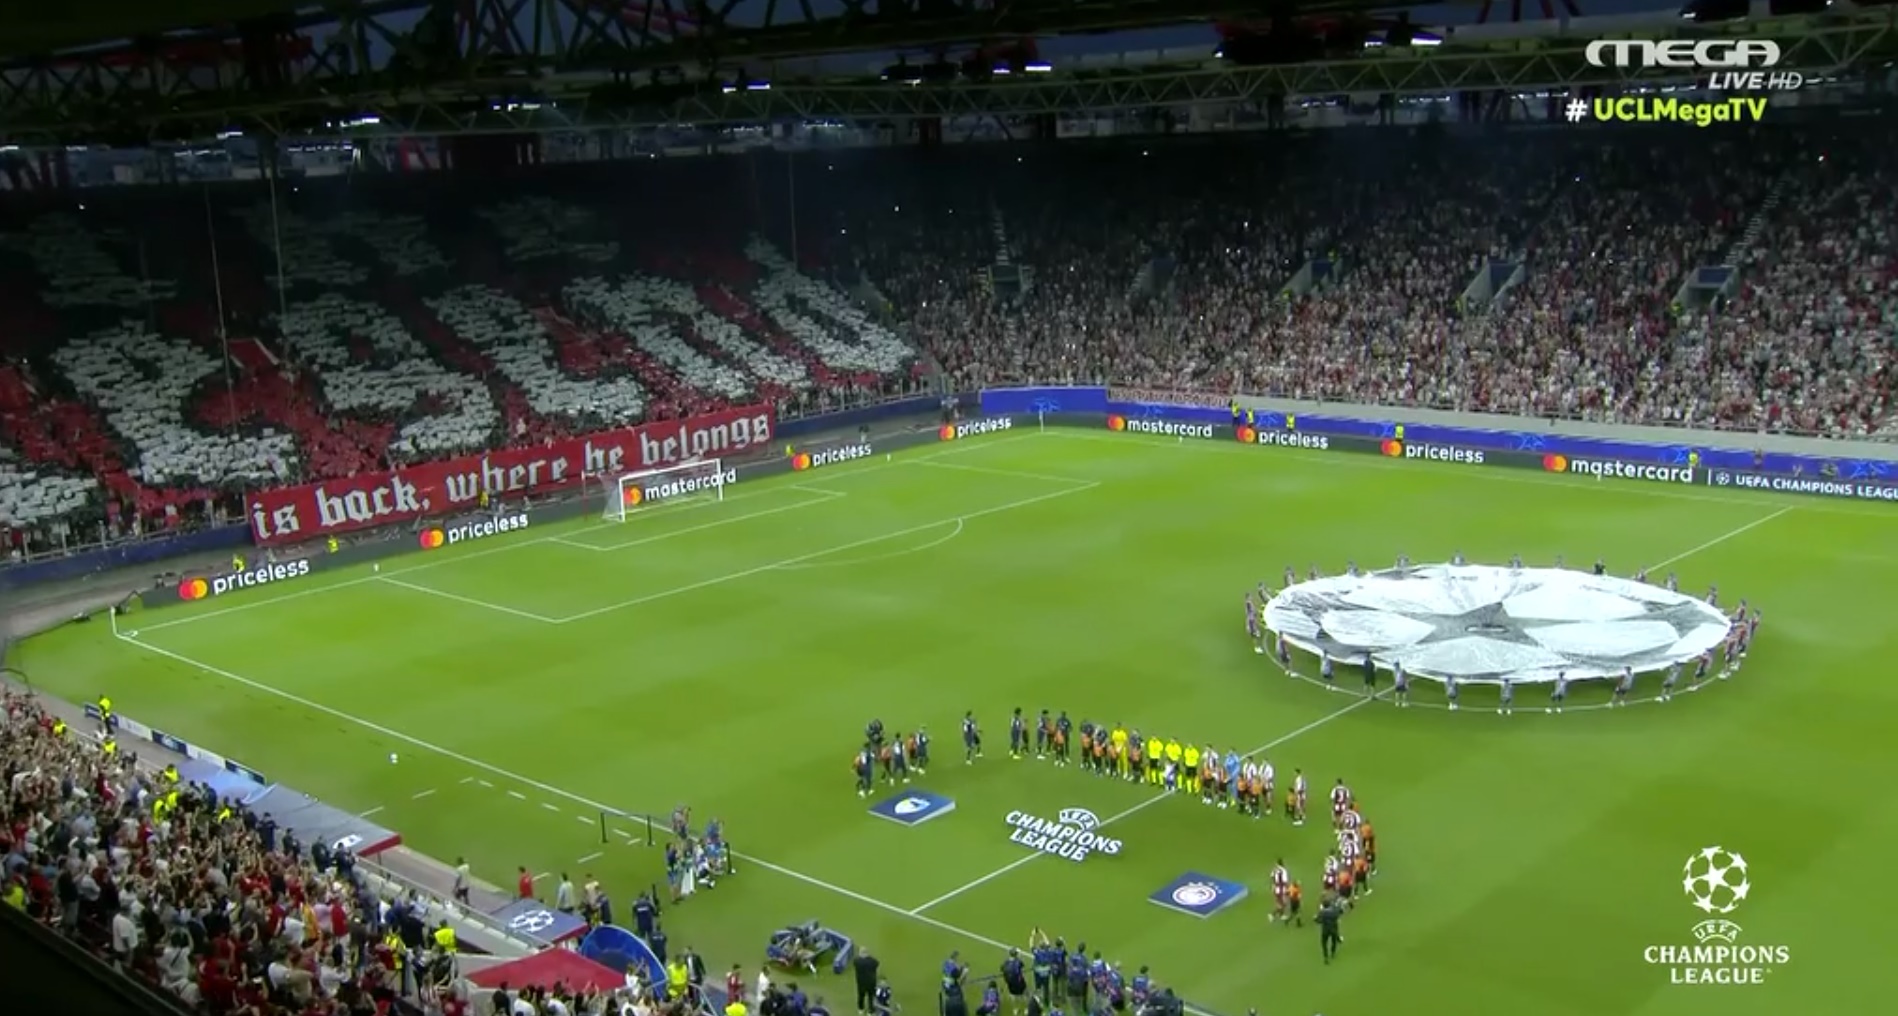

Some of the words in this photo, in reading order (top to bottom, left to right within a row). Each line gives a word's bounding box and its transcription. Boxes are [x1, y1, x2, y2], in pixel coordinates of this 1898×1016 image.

[957, 416, 1011, 438] priceless
[1127, 418, 1213, 438] mastercard
[1258, 431, 1328, 449] priceless
[812, 442, 871, 467] priceless
[1405, 444, 1484, 463] priceless
[252, 502, 300, 540] is
[314, 475, 431, 527] back,
[445, 451, 567, 502] where
[585, 440, 624, 476] he
[640, 414, 771, 466] belongs
[1571, 458, 1693, 483] mastercard
[645, 467, 737, 500] mastercard
[1736, 475, 1769, 488] UEFA
[1773, 478, 1852, 496] CHAMPIONS
[448, 511, 529, 543] priceless
[213, 559, 309, 595] priceless
[1005, 810, 1123, 854] CHAMPIONS
[1008, 828, 1089, 862] LEAGUE
